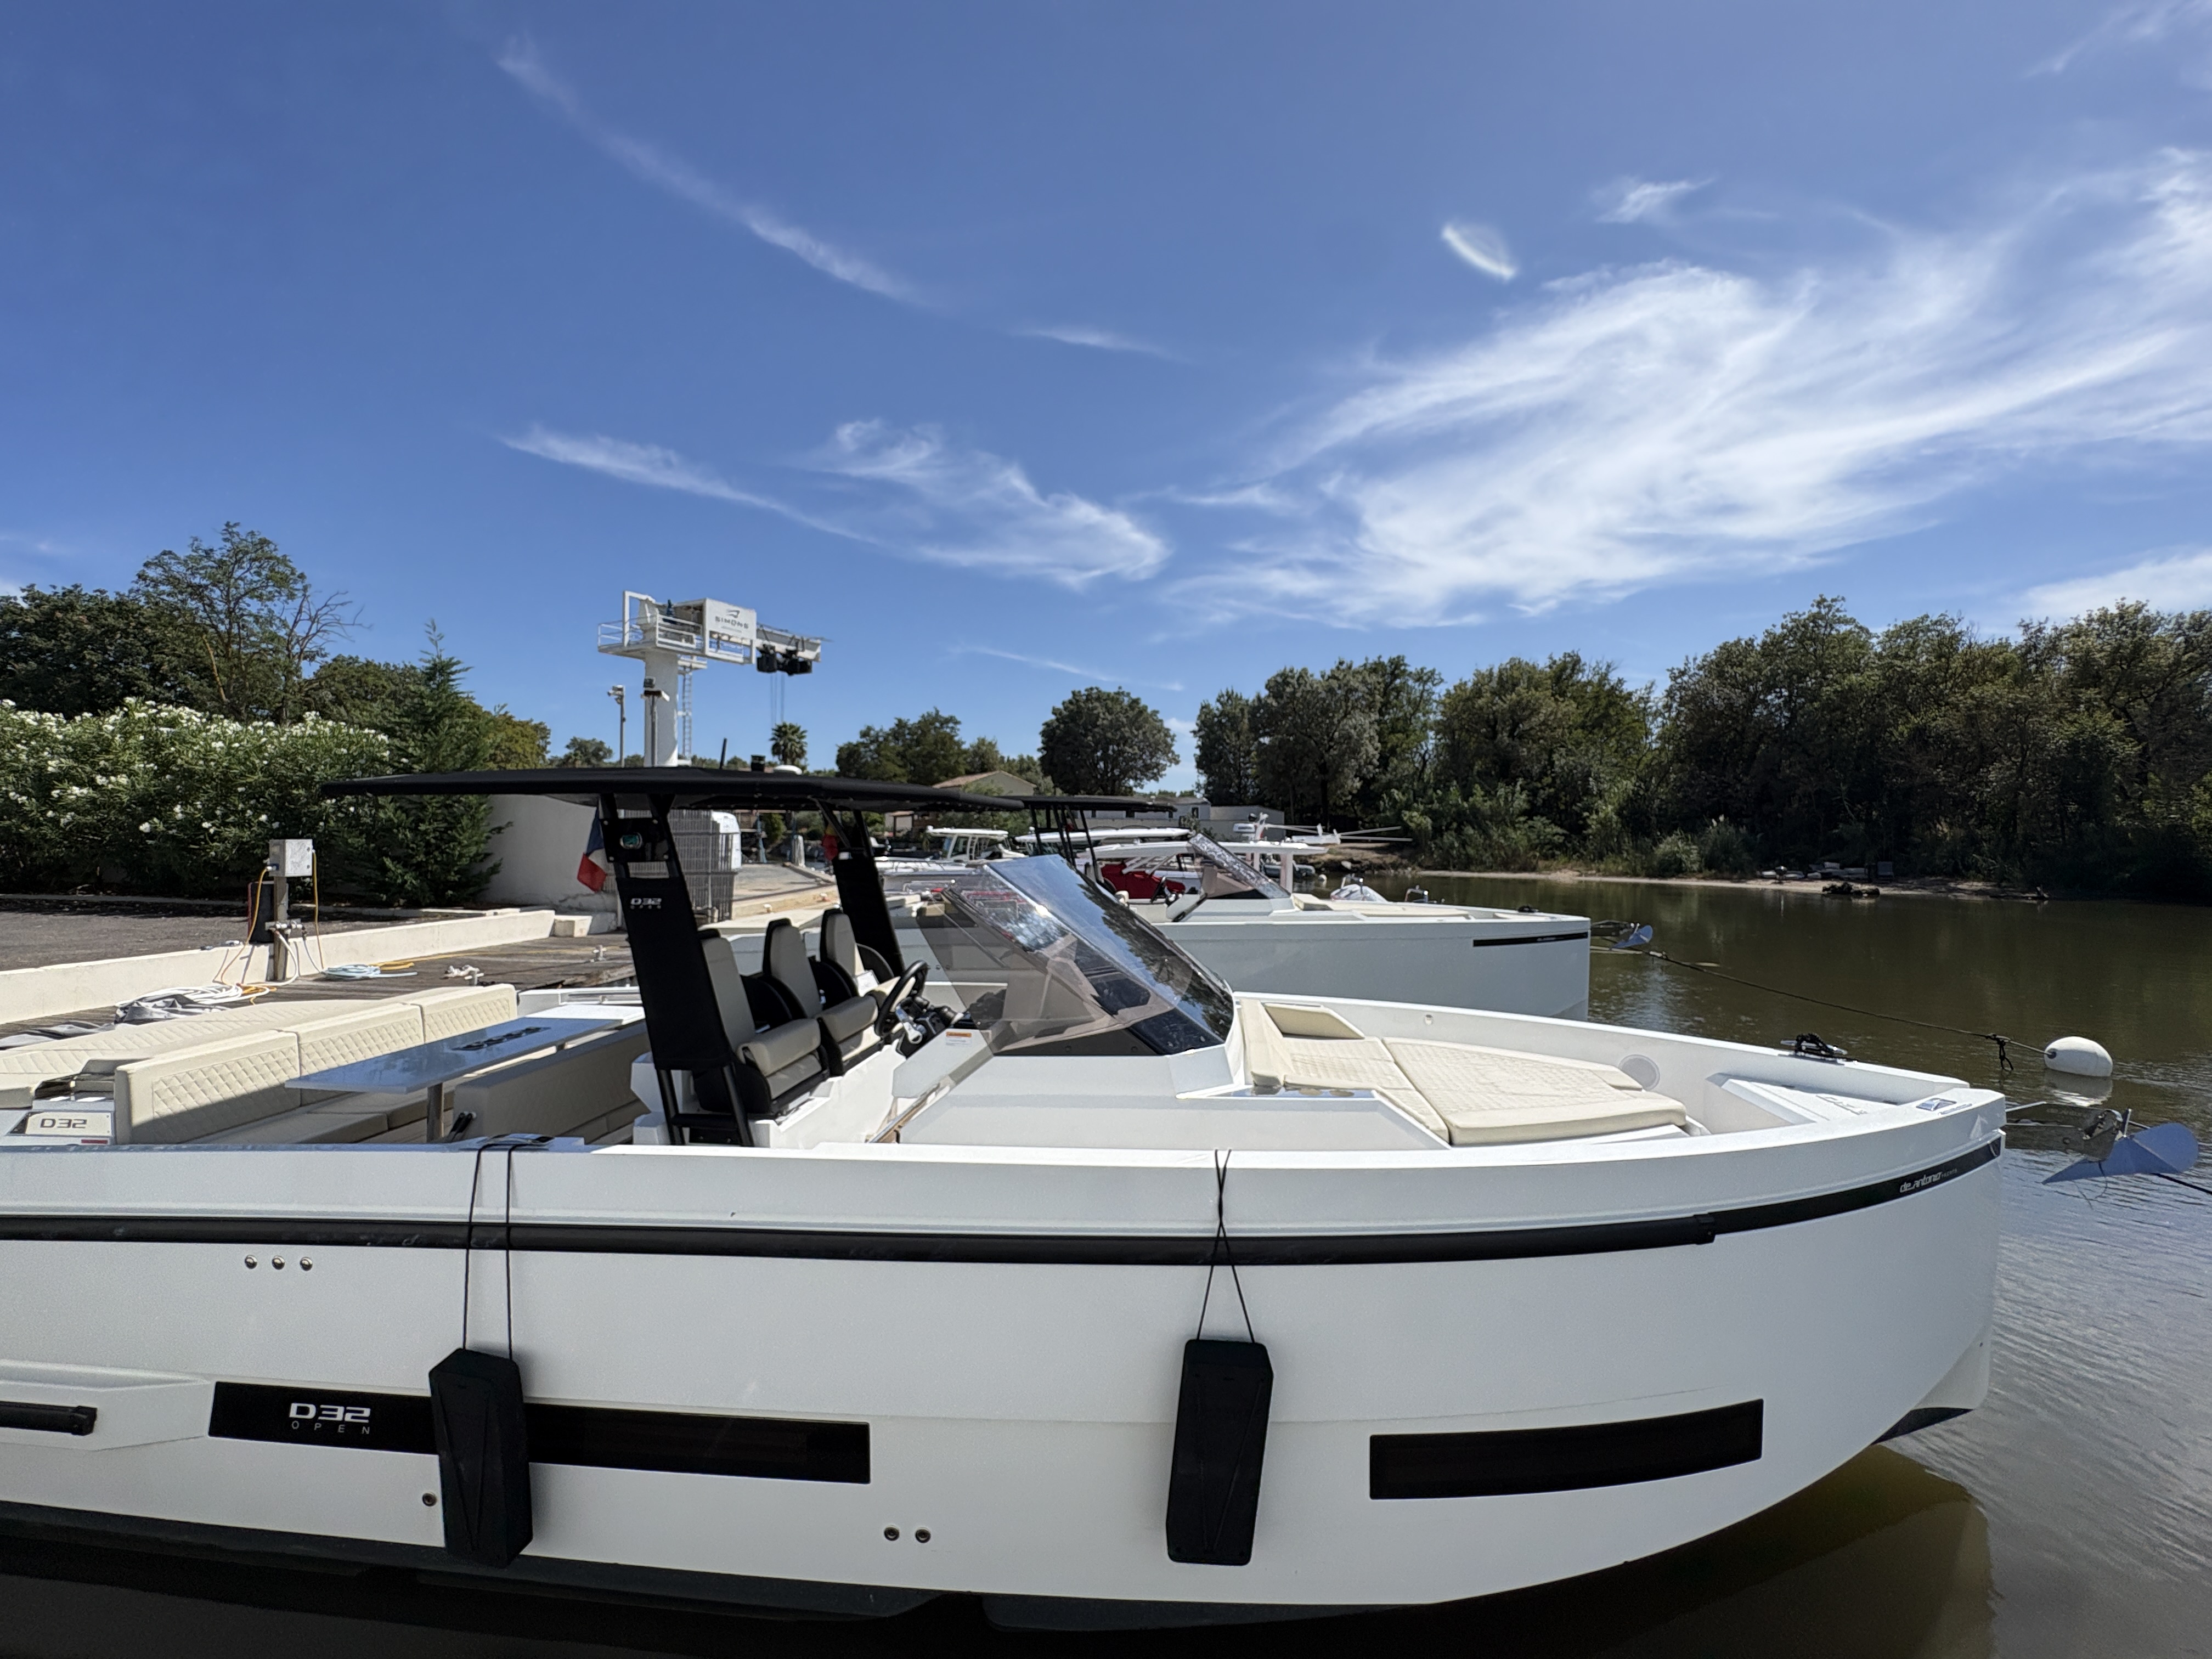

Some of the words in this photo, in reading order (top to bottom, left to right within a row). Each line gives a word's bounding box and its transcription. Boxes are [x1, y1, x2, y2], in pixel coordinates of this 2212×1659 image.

[40, 1118, 87, 1128] D32
[289, 1403, 371, 1423] D32
[291, 1420, 370, 1435] OPEN
